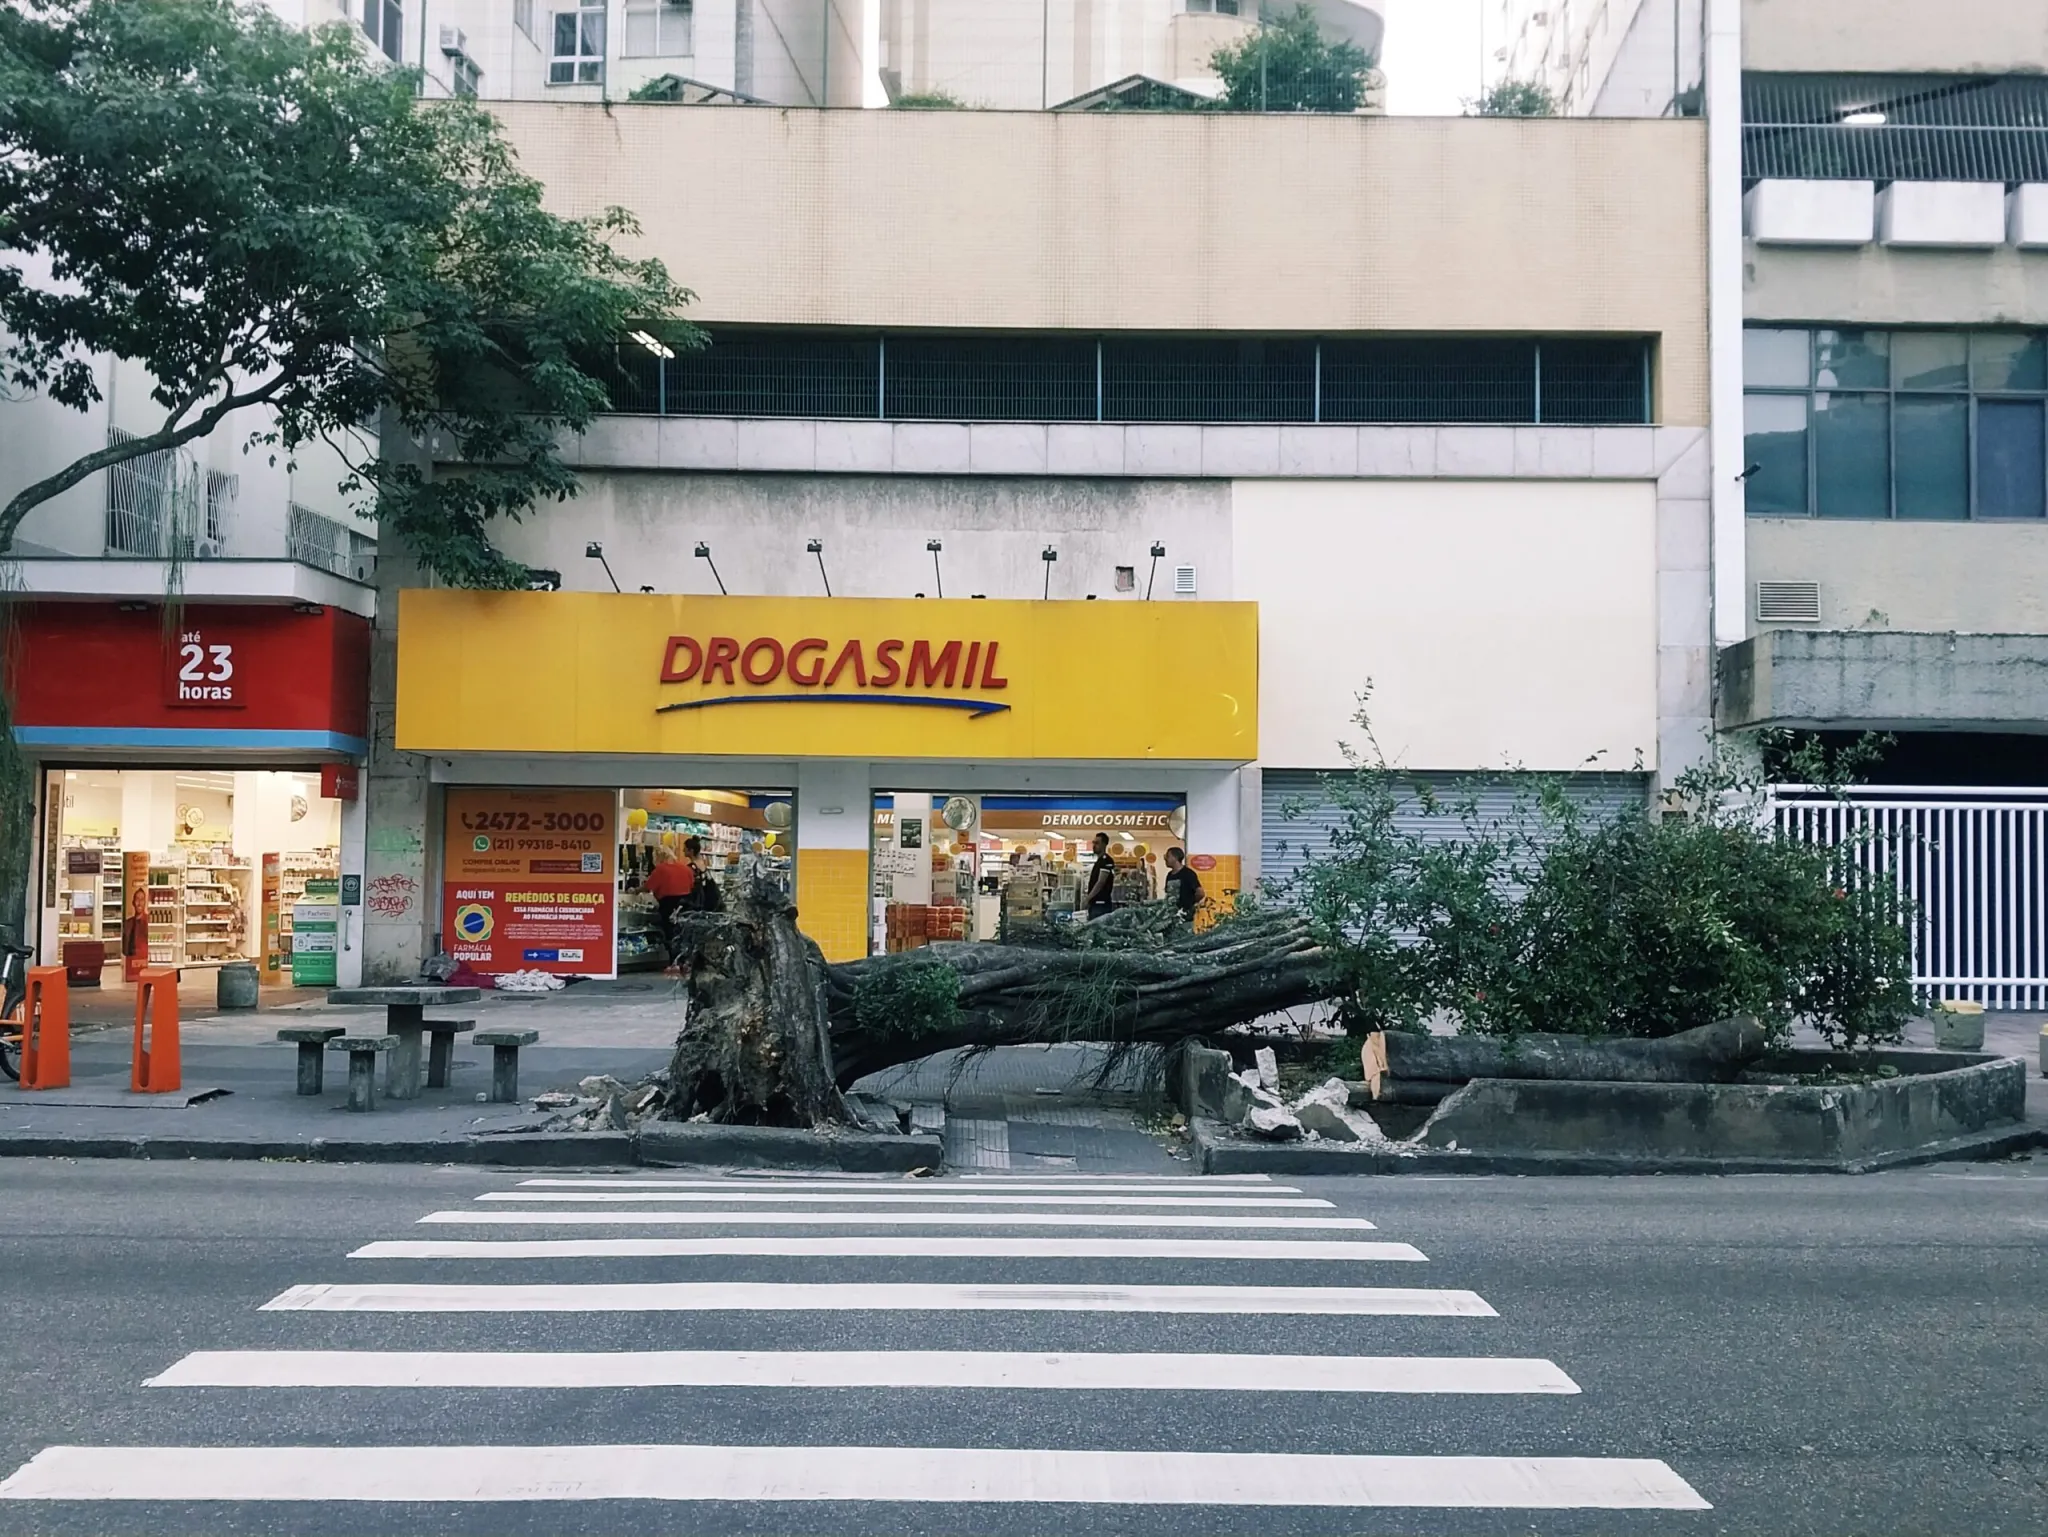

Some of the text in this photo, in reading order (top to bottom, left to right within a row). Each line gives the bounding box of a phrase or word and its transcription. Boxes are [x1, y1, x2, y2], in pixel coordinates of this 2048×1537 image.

[181, 630, 201, 643] até
[179, 644, 233, 682] 23
[660, 636, 1008, 688] DROGASMIL
[179, 681, 232, 700] horas
[475, 811, 605, 831] 2472-3000
[1042, 812, 1169, 826] DERMOCOSMÉTIC
[492, 838, 514, 851] (21)
[477, 890, 495, 900] TEM
[505, 891, 605, 906] REMÉDIOS DE GRAÇA
[453, 943, 492, 952] FARMÁCIA
[453, 952, 492, 961] POPULAR
